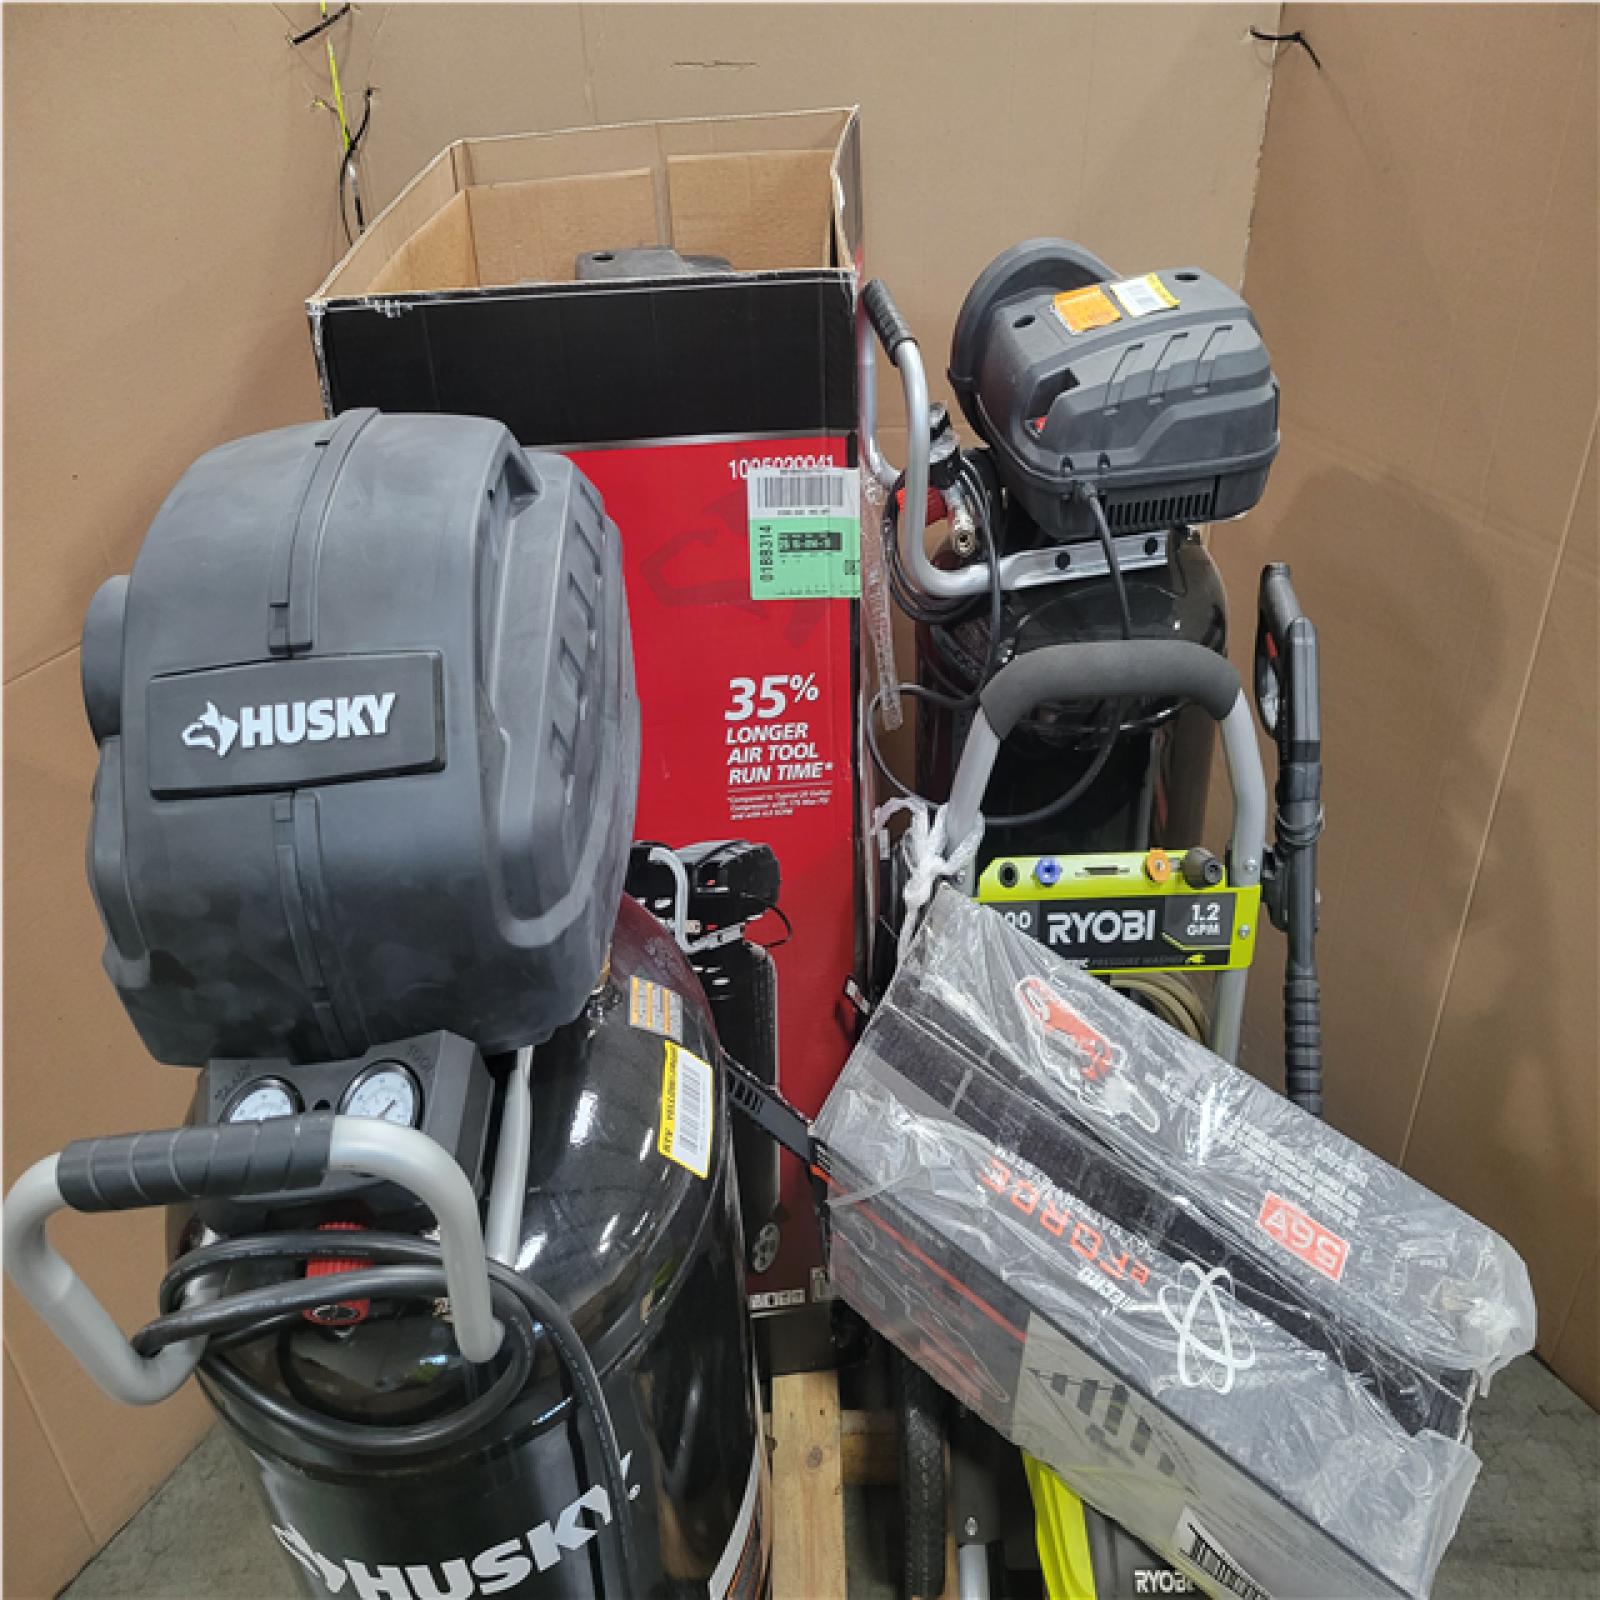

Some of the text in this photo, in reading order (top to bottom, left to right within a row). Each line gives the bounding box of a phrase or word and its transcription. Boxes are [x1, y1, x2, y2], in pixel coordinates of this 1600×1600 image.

[724, 671, 820, 721] 35%
[239, 691, 397, 749] HUSKY
[726, 722, 809, 745] LONGER
[727, 742, 819, 766] AIR TOOL
[728, 764, 772, 786] RUN
[1191, 902, 1221, 922] 1.2
[1046, 909, 1156, 945] RYOBI
[1186, 923, 1221, 937] GPM
